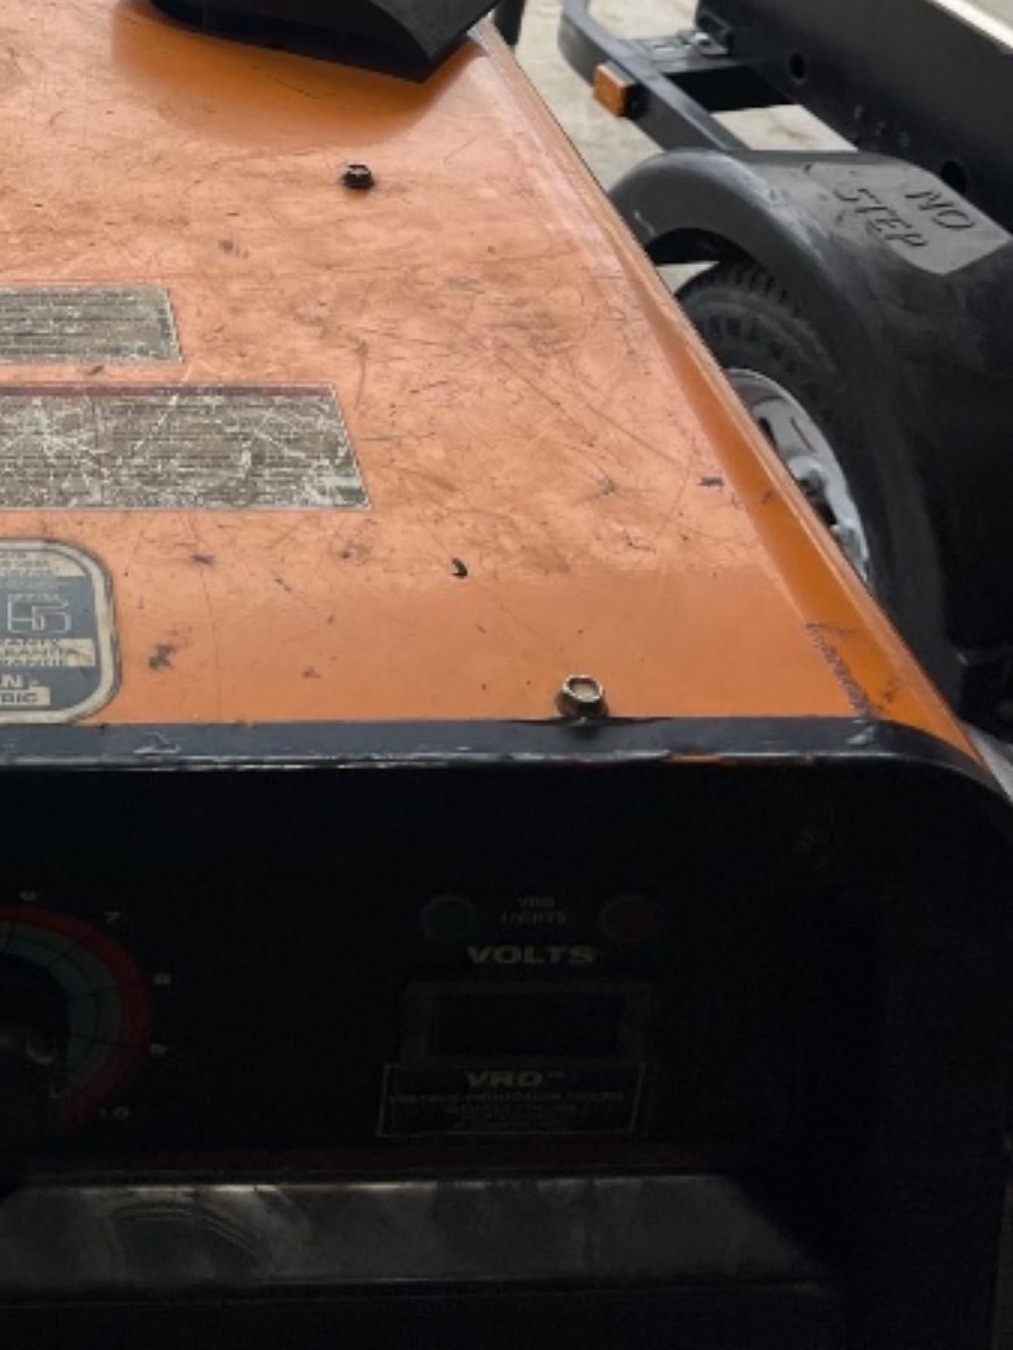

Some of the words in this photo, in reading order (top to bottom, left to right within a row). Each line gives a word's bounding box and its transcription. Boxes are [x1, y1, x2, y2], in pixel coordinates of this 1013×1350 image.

[833, 187, 928, 247] STEP
[905, 190, 976, 229] NO
[466, 944, 597, 965] VOLTS
